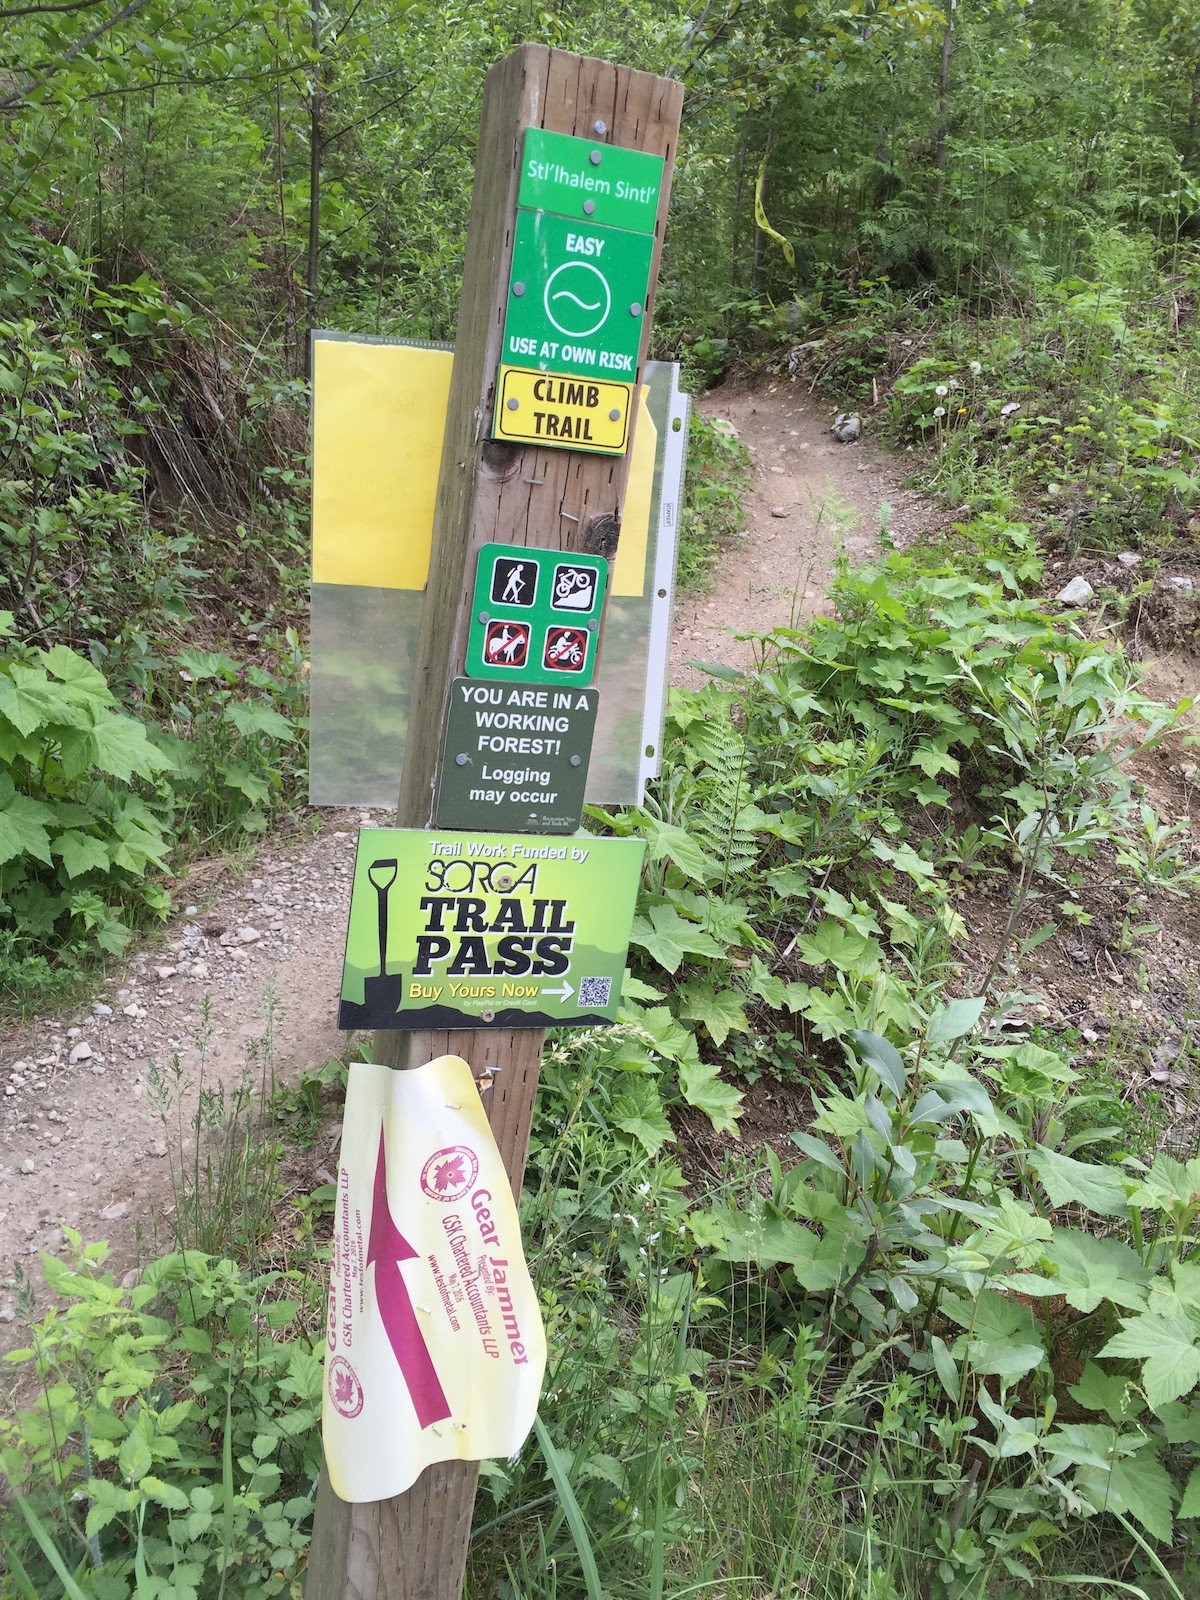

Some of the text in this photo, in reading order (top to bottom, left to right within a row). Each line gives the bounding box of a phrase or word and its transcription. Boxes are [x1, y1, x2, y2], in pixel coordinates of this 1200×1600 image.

[566, 233, 605, 257] EASY
[509, 336, 633, 371] USE AT OWN RISK
[533, 379, 599, 408] CLIMB
[533, 412, 593, 440] TRAIL
[461, 686, 589, 711] YOU ARE IN A
[475, 711, 570, 732] WORKING
[478, 736, 561, 756] FOREST!
[482, 765, 550, 786] Logging
[470, 788, 558, 805] may occur
[429, 840, 589, 864] Trail Work Funded by
[420, 896, 576, 934] TRAIL
[412, 936, 574, 977] PASS
[409, 983, 540, 1000] Buy Yours Now
[342, 1193, 350, 1261] Accountants
[356, 1210, 364, 1312] www.testofmetal.com
[477, 1254, 494, 1284] Presented
[442, 1214, 500, 1358] GSK Chartered Accountants LLP
[471, 1189, 528, 1364] Gear Jammer
[342, 1263, 352, 1319] Chartered
[428, 1254, 460, 1332] www.testofmetal.com
[453, 1288, 464, 1302] 2016
[343, 1322, 352, 1348] GSK
